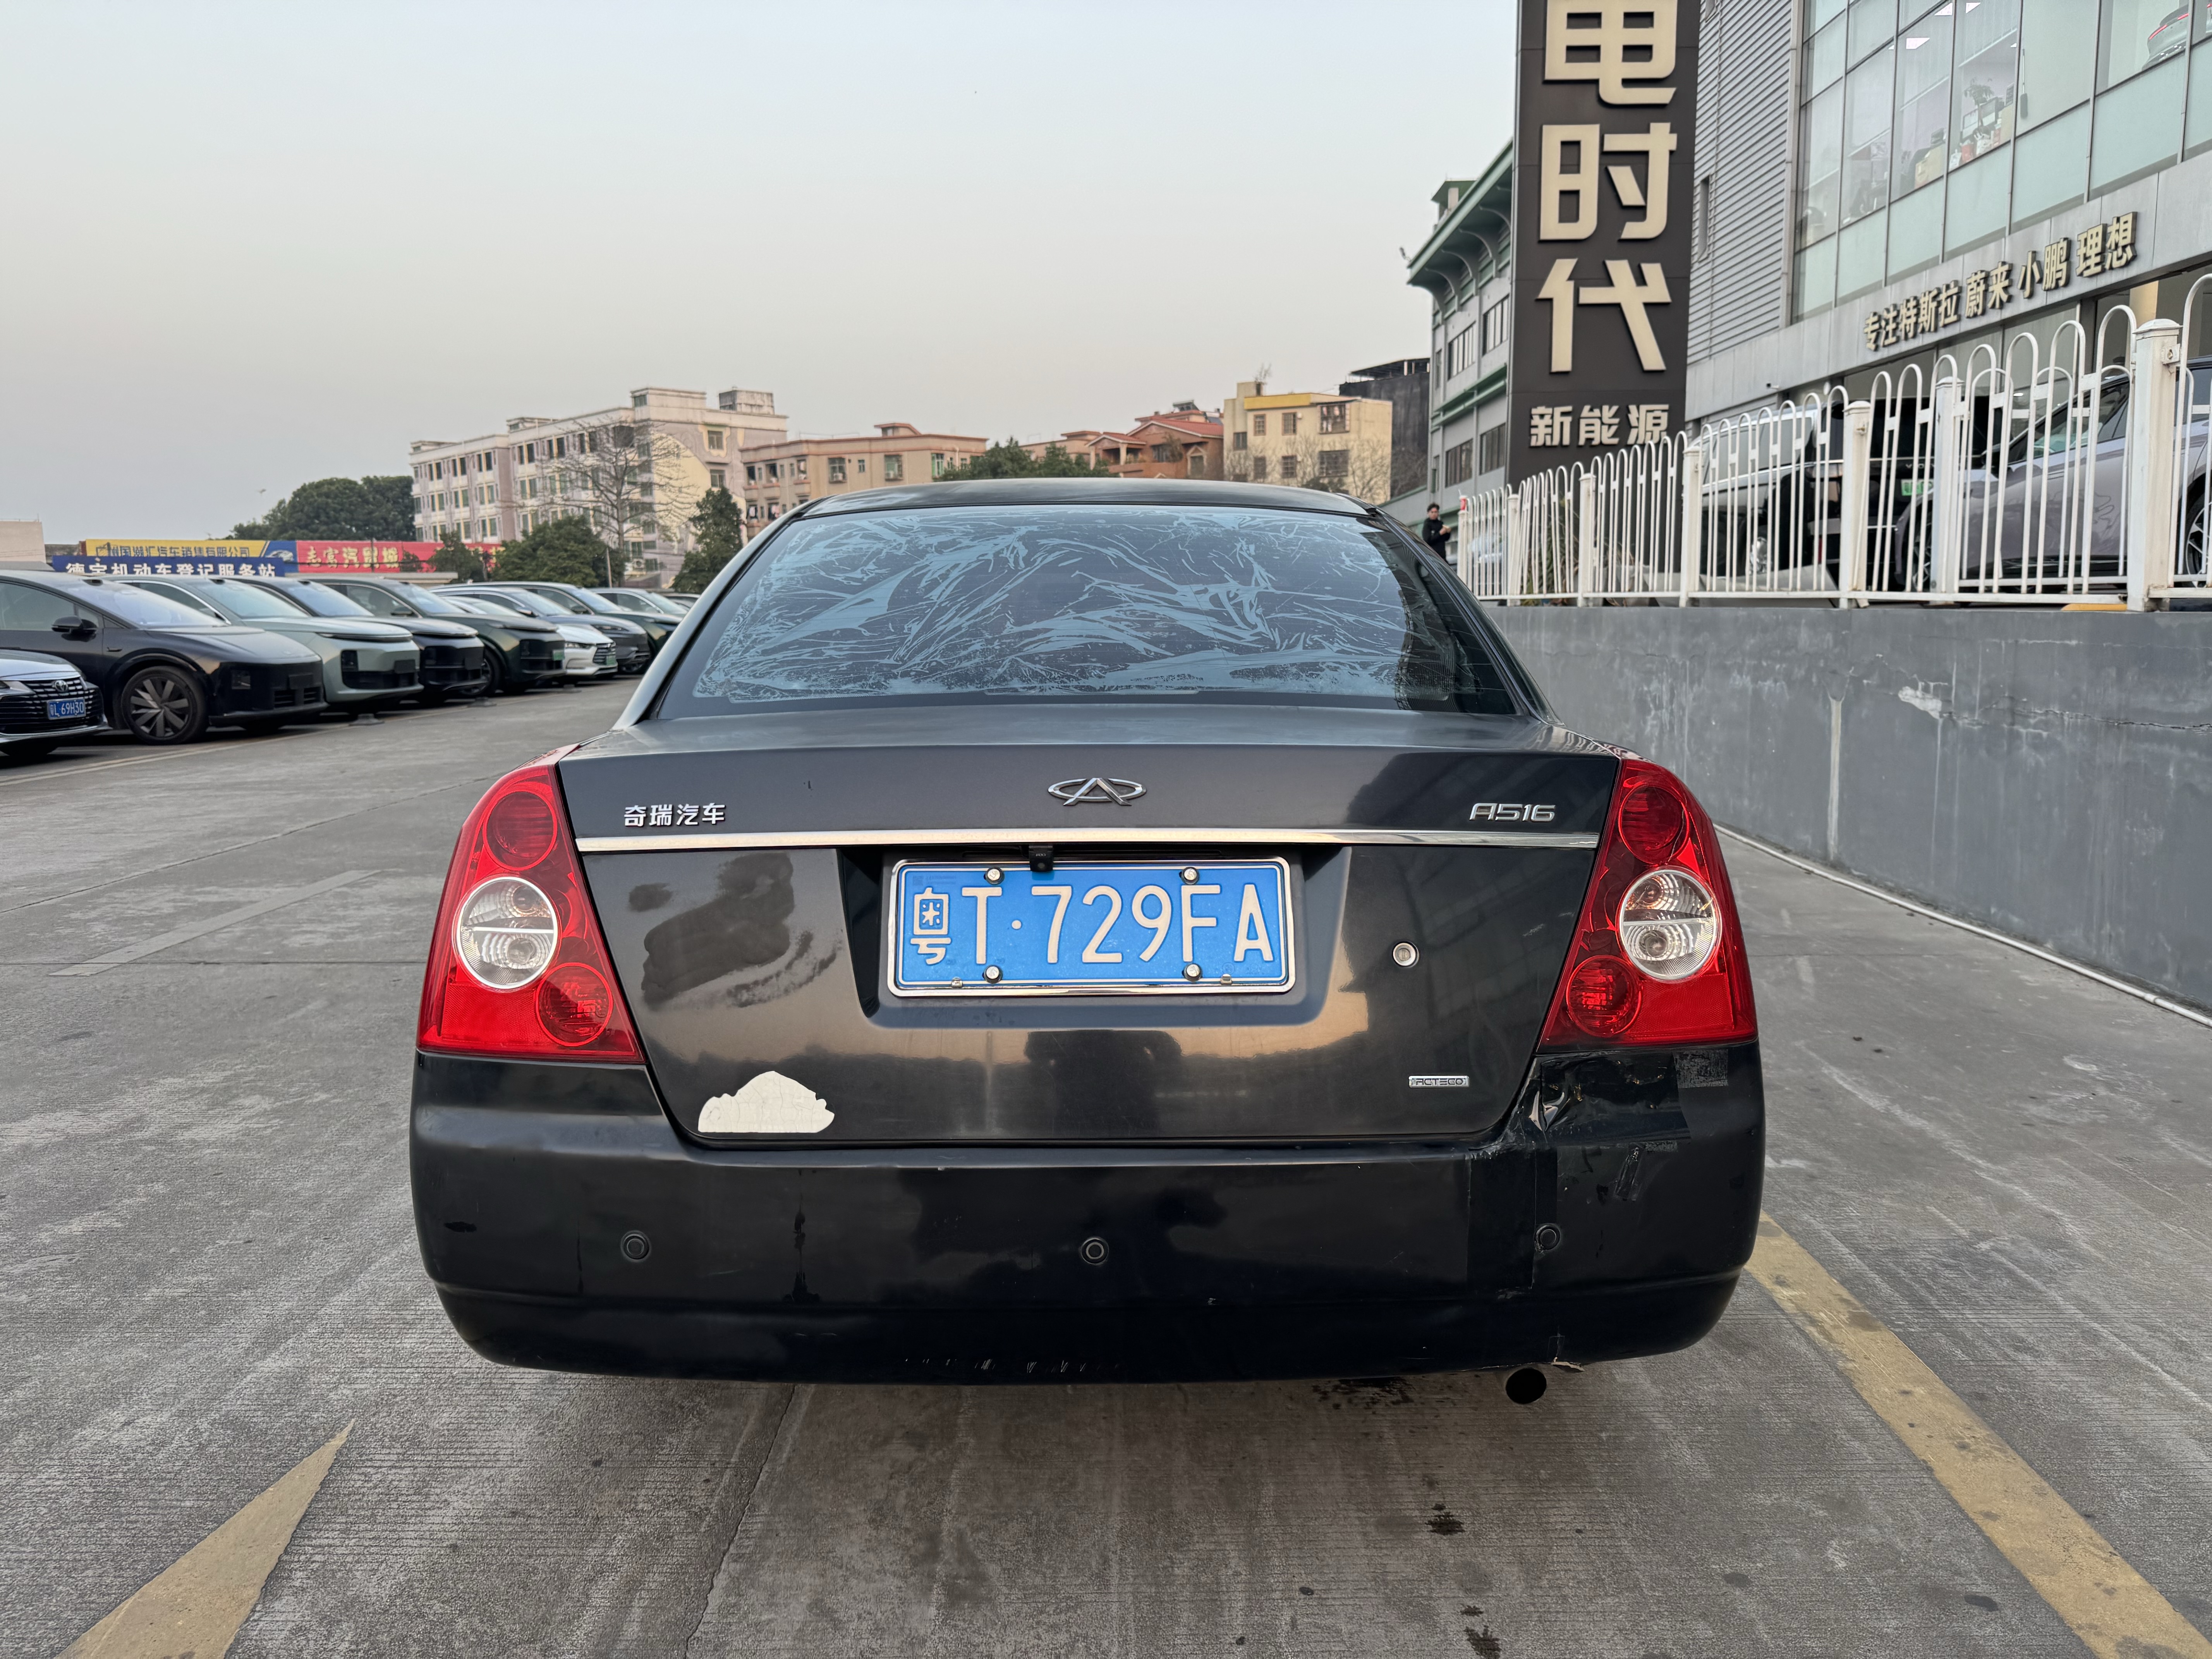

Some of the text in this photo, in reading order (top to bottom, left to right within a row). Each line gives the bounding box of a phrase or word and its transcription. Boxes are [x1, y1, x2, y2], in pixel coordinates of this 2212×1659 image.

[1537, 0, 1677, 372] 电时代
[1863, 211, 2137, 351] 专注特斯拉 蔚来 小鹏 理想
[1530, 404, 1669, 447] 新能源
[624, 803, 726, 826] 奇瑞汽车
[1469, 803, 1556, 822] A516
